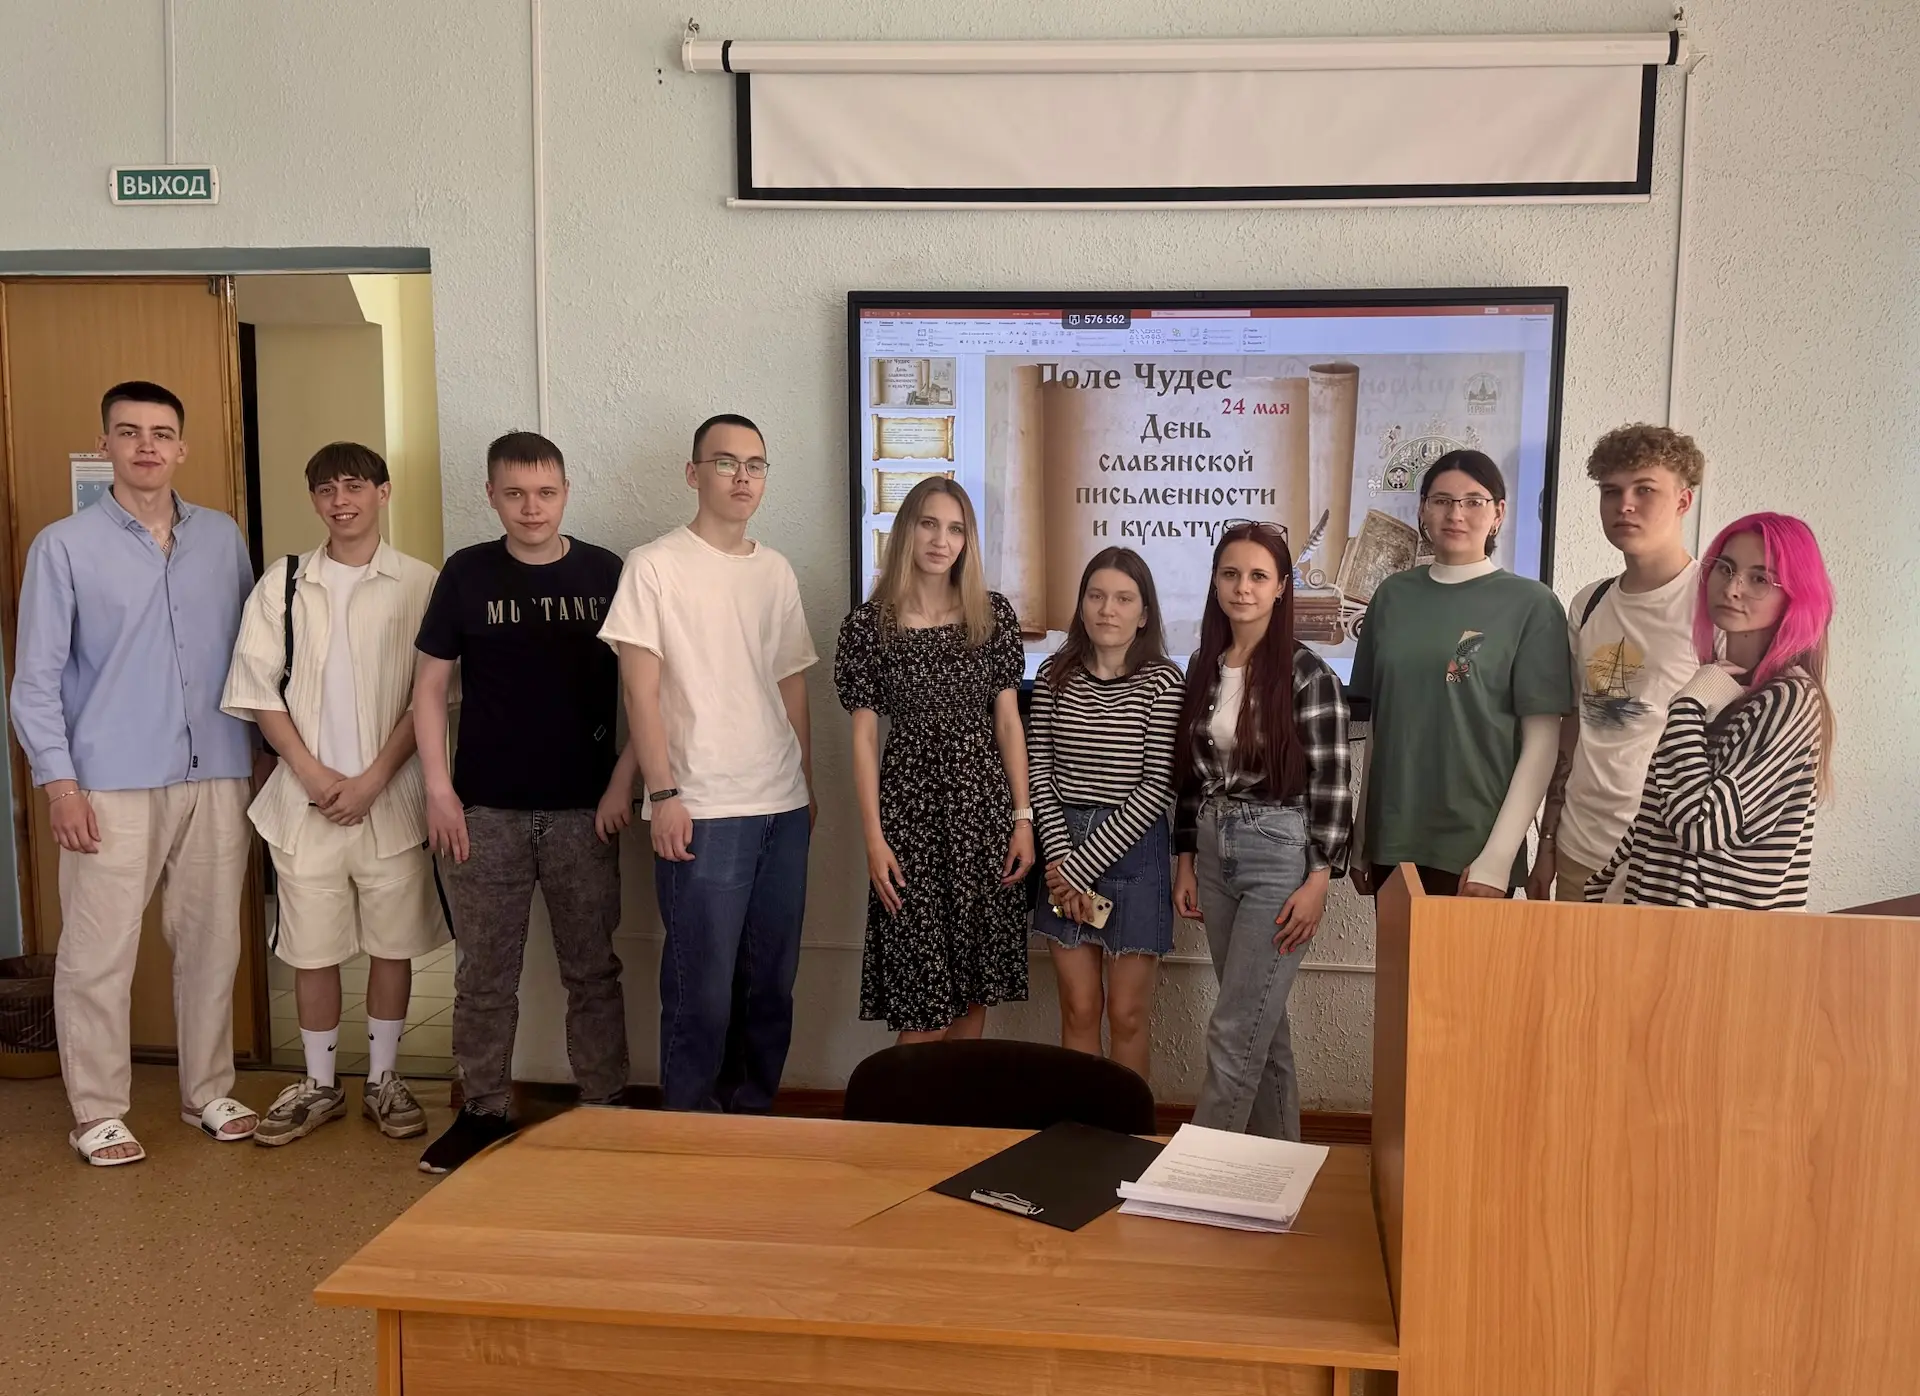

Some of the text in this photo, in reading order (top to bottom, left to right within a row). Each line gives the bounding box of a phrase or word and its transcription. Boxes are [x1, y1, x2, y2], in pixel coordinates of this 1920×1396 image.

[123, 175, 207, 196] ВЫХОД
[1084, 314, 1125, 324] 576 562
[1037, 363, 1232, 396] Поле Чудес
[1222, 398, 1290, 415] 24 мая
[1140, 414, 1212, 444] День
[1099, 449, 1253, 473] славянской
[1076, 486, 1276, 506] письменности
[1093, 520, 1220, 545] и культу
